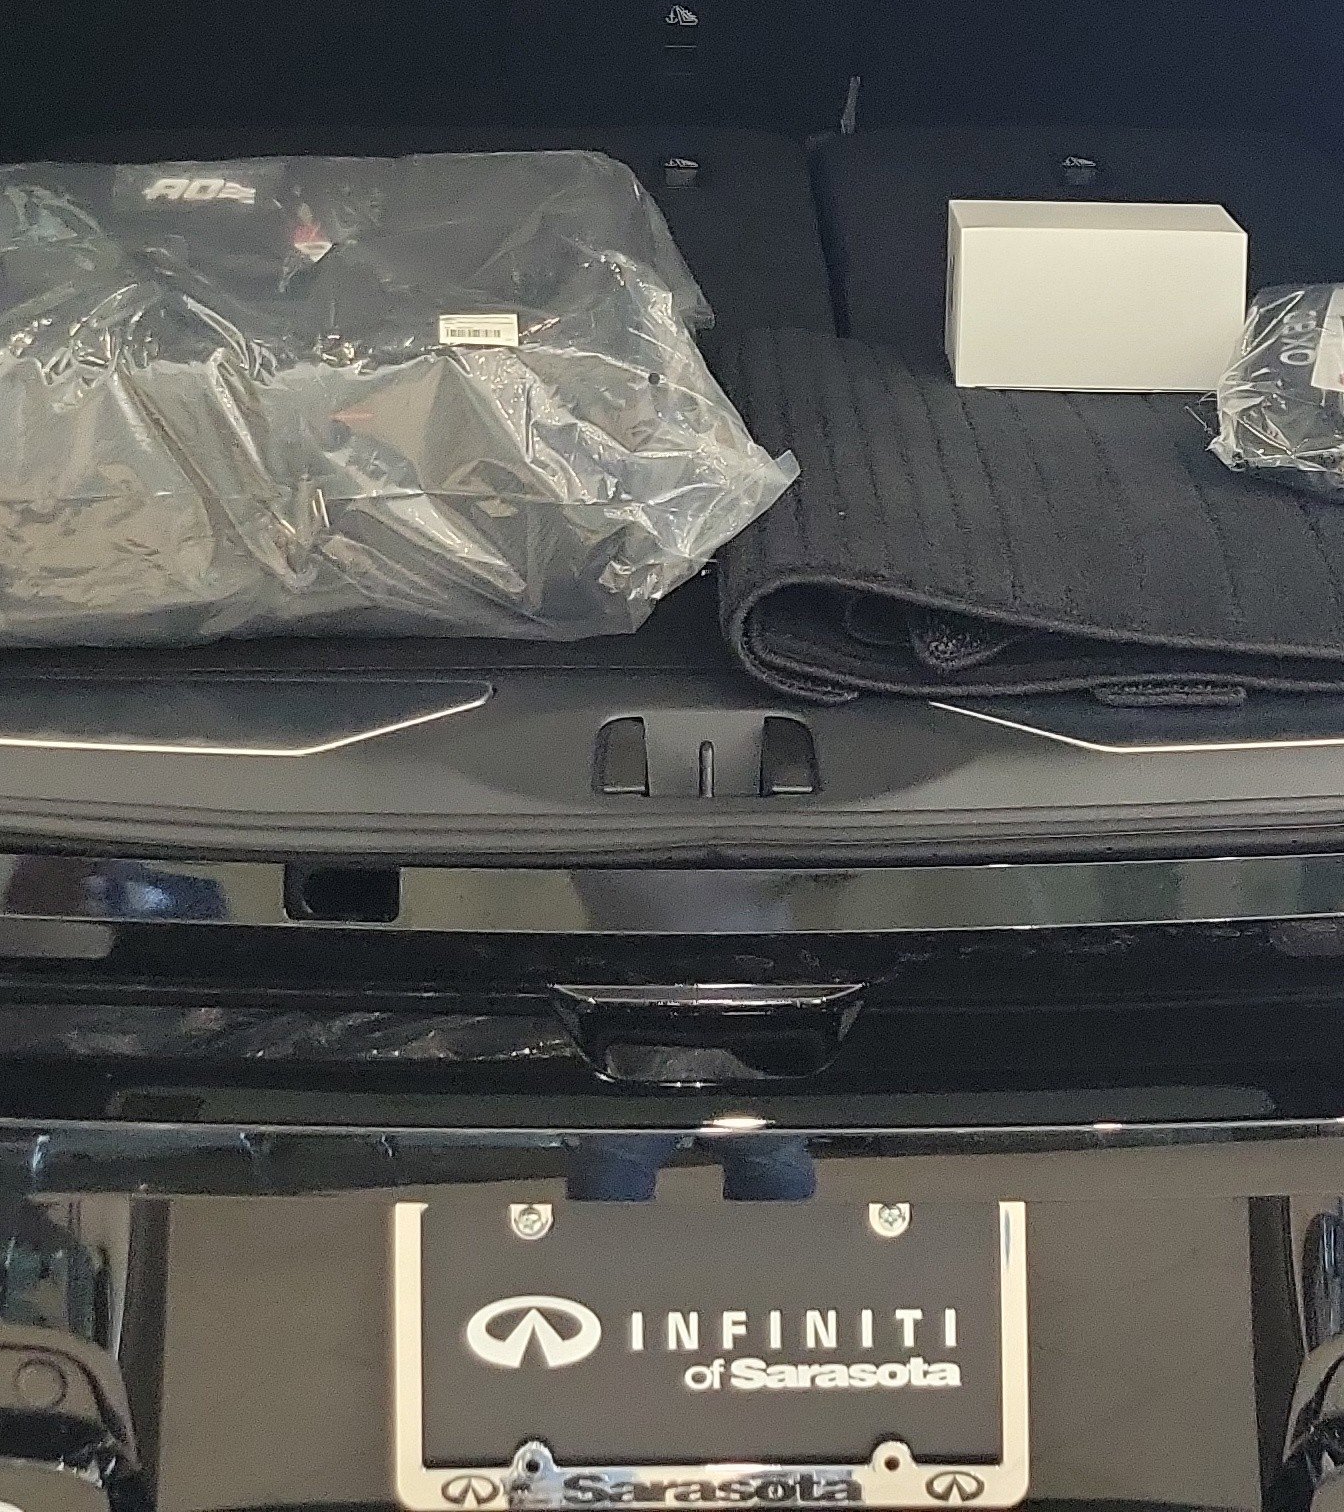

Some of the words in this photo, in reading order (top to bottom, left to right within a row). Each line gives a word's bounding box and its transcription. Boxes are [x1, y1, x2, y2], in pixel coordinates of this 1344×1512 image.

[631, 1308, 957, 1351] INFINITI
[684, 1357, 726, 1390] of
[731, 1357, 961, 1389] Sarasota
[564, 1472, 864, 1504] Sarasota
